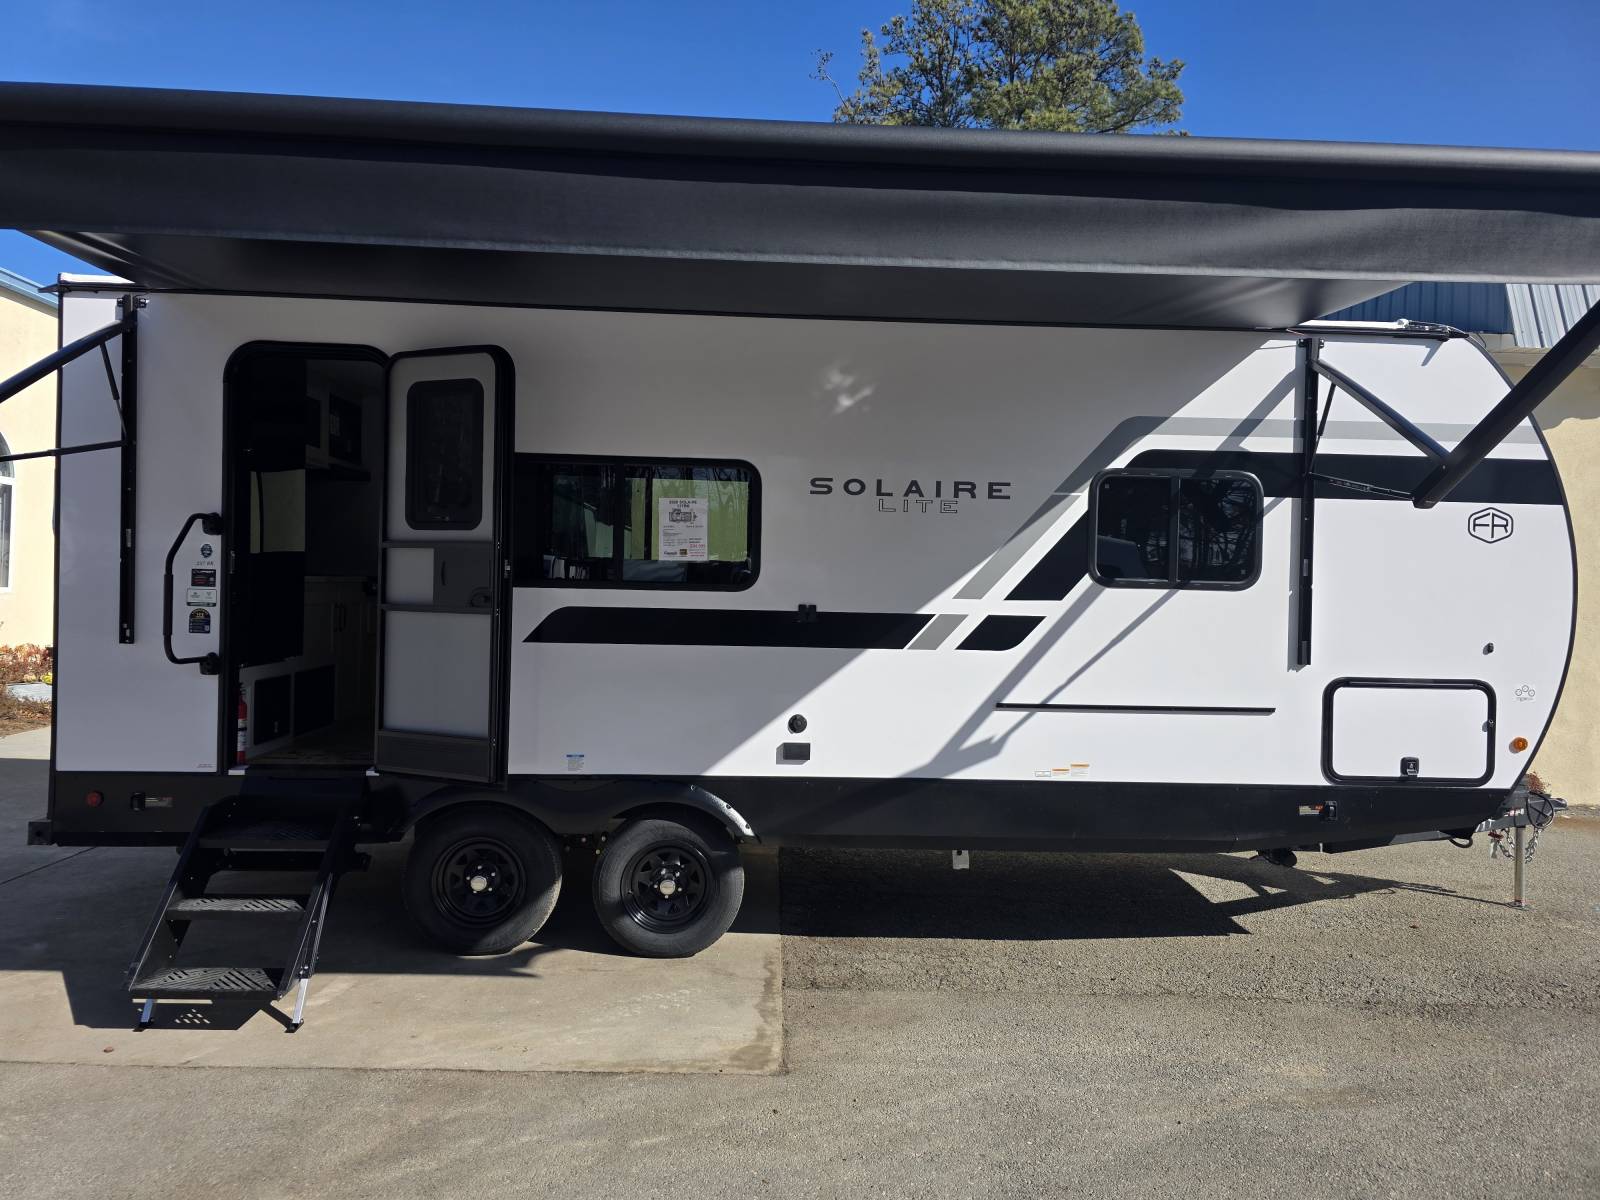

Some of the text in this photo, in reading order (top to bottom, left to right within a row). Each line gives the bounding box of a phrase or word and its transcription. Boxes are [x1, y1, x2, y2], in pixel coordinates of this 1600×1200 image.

[810, 477, 1011, 500] SOLAIRE
[878, 498, 959, 514] LITE
[1472, 511, 1510, 540] FR
